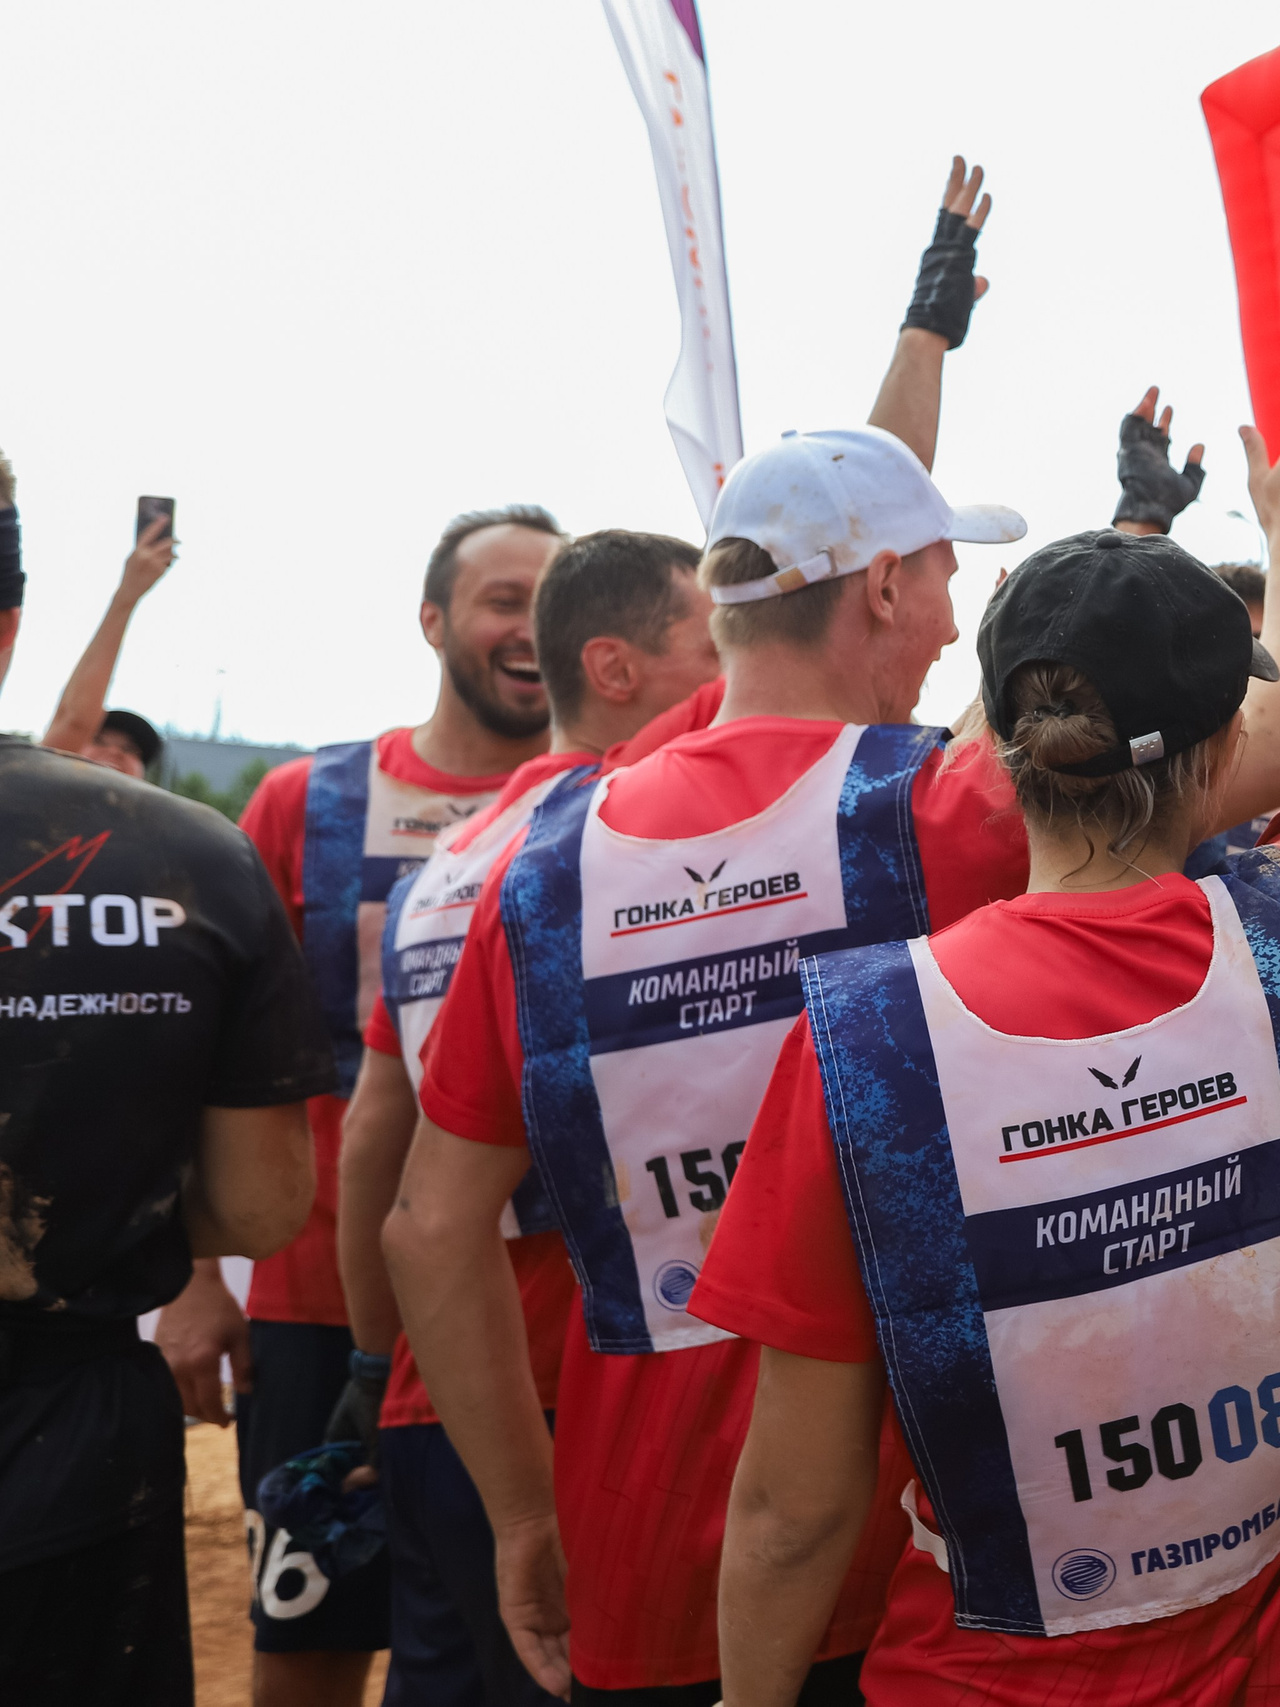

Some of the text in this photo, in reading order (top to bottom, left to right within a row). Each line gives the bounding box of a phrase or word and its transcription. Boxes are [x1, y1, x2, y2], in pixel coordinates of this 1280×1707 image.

[615, 872, 801, 928] ГОНКА ГЕРОЕВ
[628, 939, 800, 1006] КОМАНДНЫЙ
[0, 992, 192, 1021] НАДЕЖНОСТЬ
[680, 991, 757, 1029] СТАРТ
[1002, 1072, 1237, 1151] ГОНКА ГЕРОЕВ
[1036, 1155, 1242, 1248] КОМАНДНЫЙ
[1103, 1221, 1195, 1275] СТАРТ
